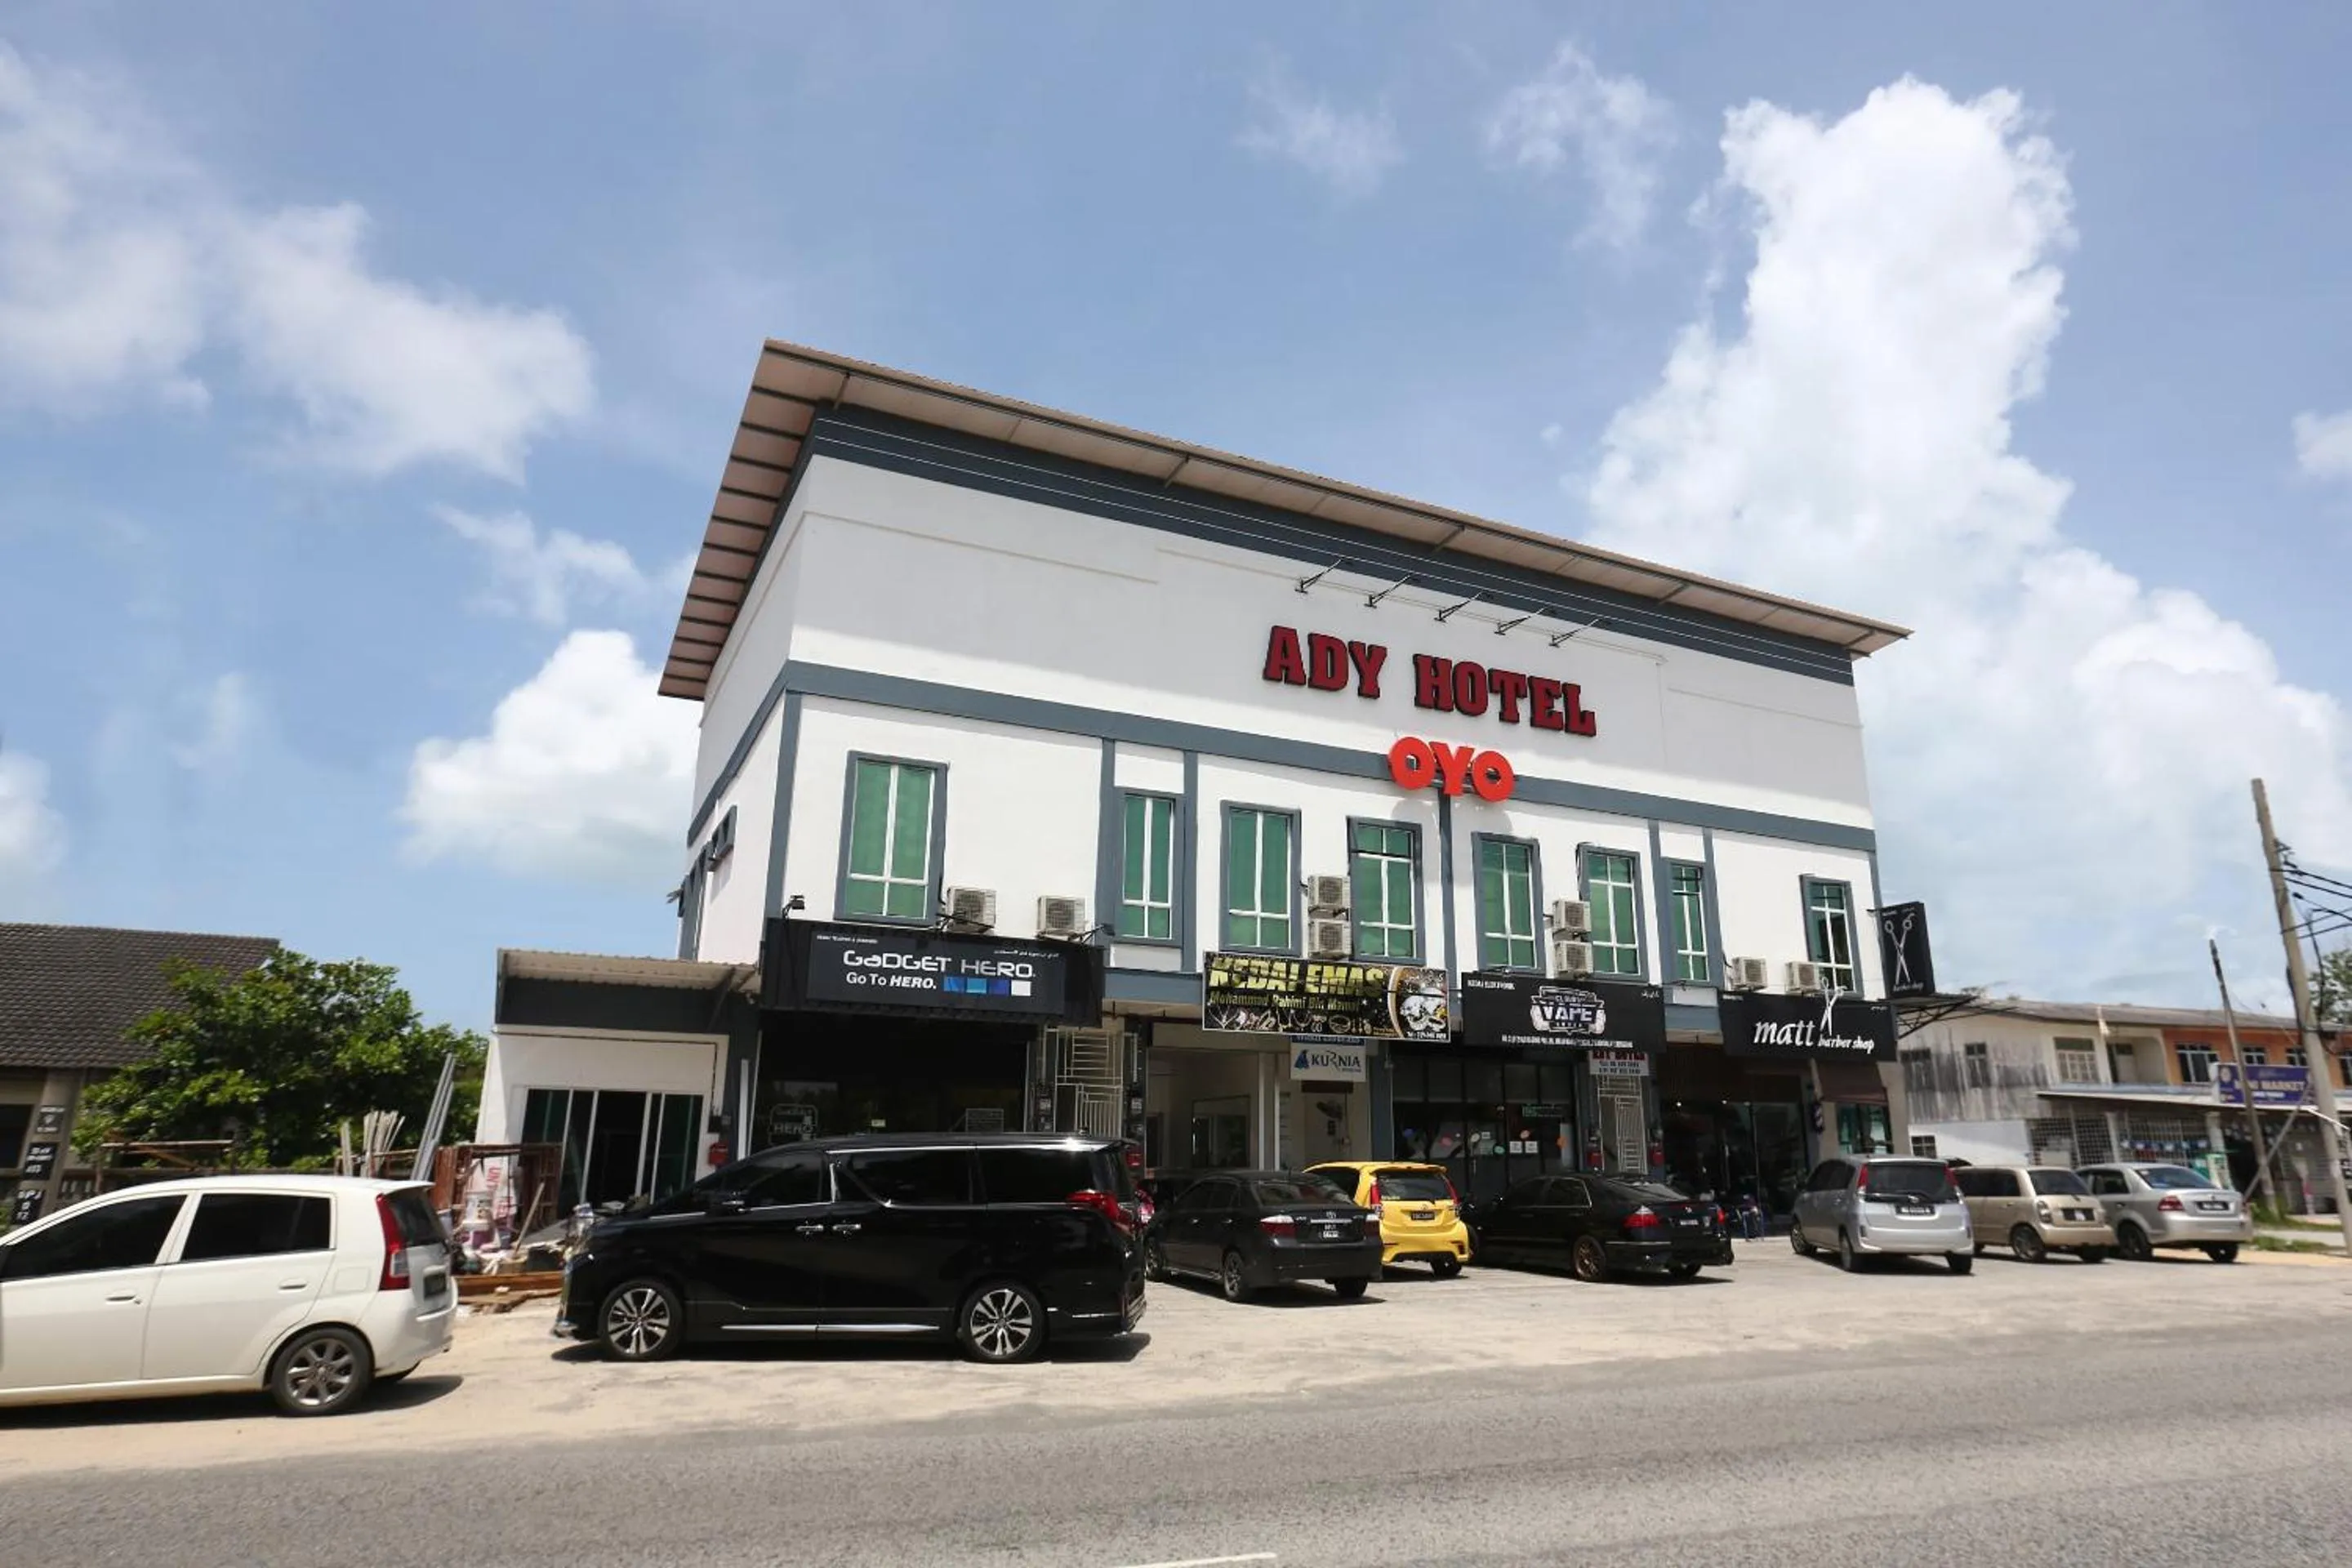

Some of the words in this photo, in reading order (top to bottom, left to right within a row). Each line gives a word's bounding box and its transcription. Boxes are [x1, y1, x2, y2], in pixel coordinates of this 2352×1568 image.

[1263, 626, 1388, 699] ADY
[1412, 653, 1597, 737] HOTEL
[1388, 737, 1515, 802] OYO
[846, 972, 866, 984] Go
[869, 973, 887, 986] To
[1305, 964, 1383, 997] EMAS
[1542, 1005, 1592, 1022] VAPE
[1753, 1020, 1815, 1047] matt
[1818, 1033, 1851, 1049] barber
[1851, 1035, 1875, 1055] shop
[1312, 1050, 1361, 1071] KURNIA
